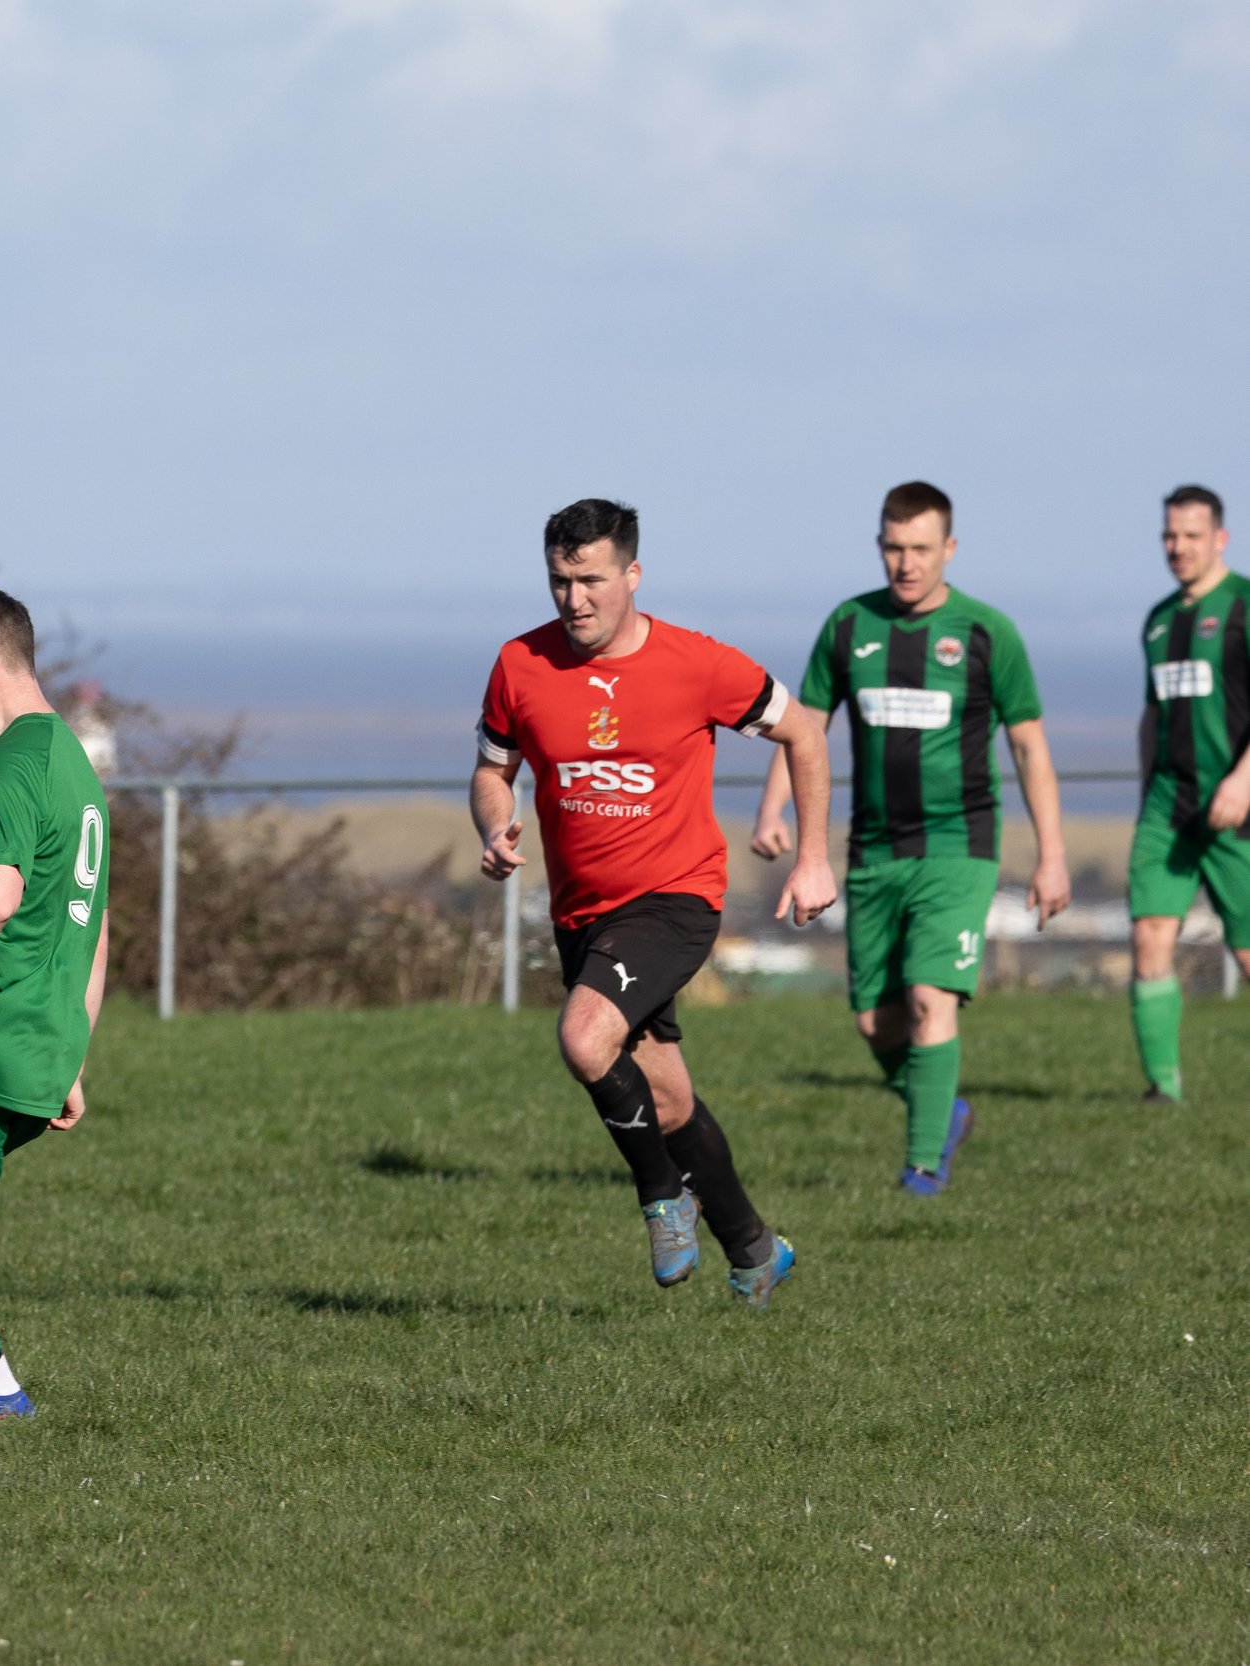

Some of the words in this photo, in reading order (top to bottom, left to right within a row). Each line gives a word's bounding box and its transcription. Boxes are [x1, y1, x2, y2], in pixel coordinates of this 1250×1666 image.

[556, 761, 655, 794] PSS
[559, 798, 595, 814] AUTO
[596, 803, 652, 817] CENTRE
[69, 804, 103, 927] 9
